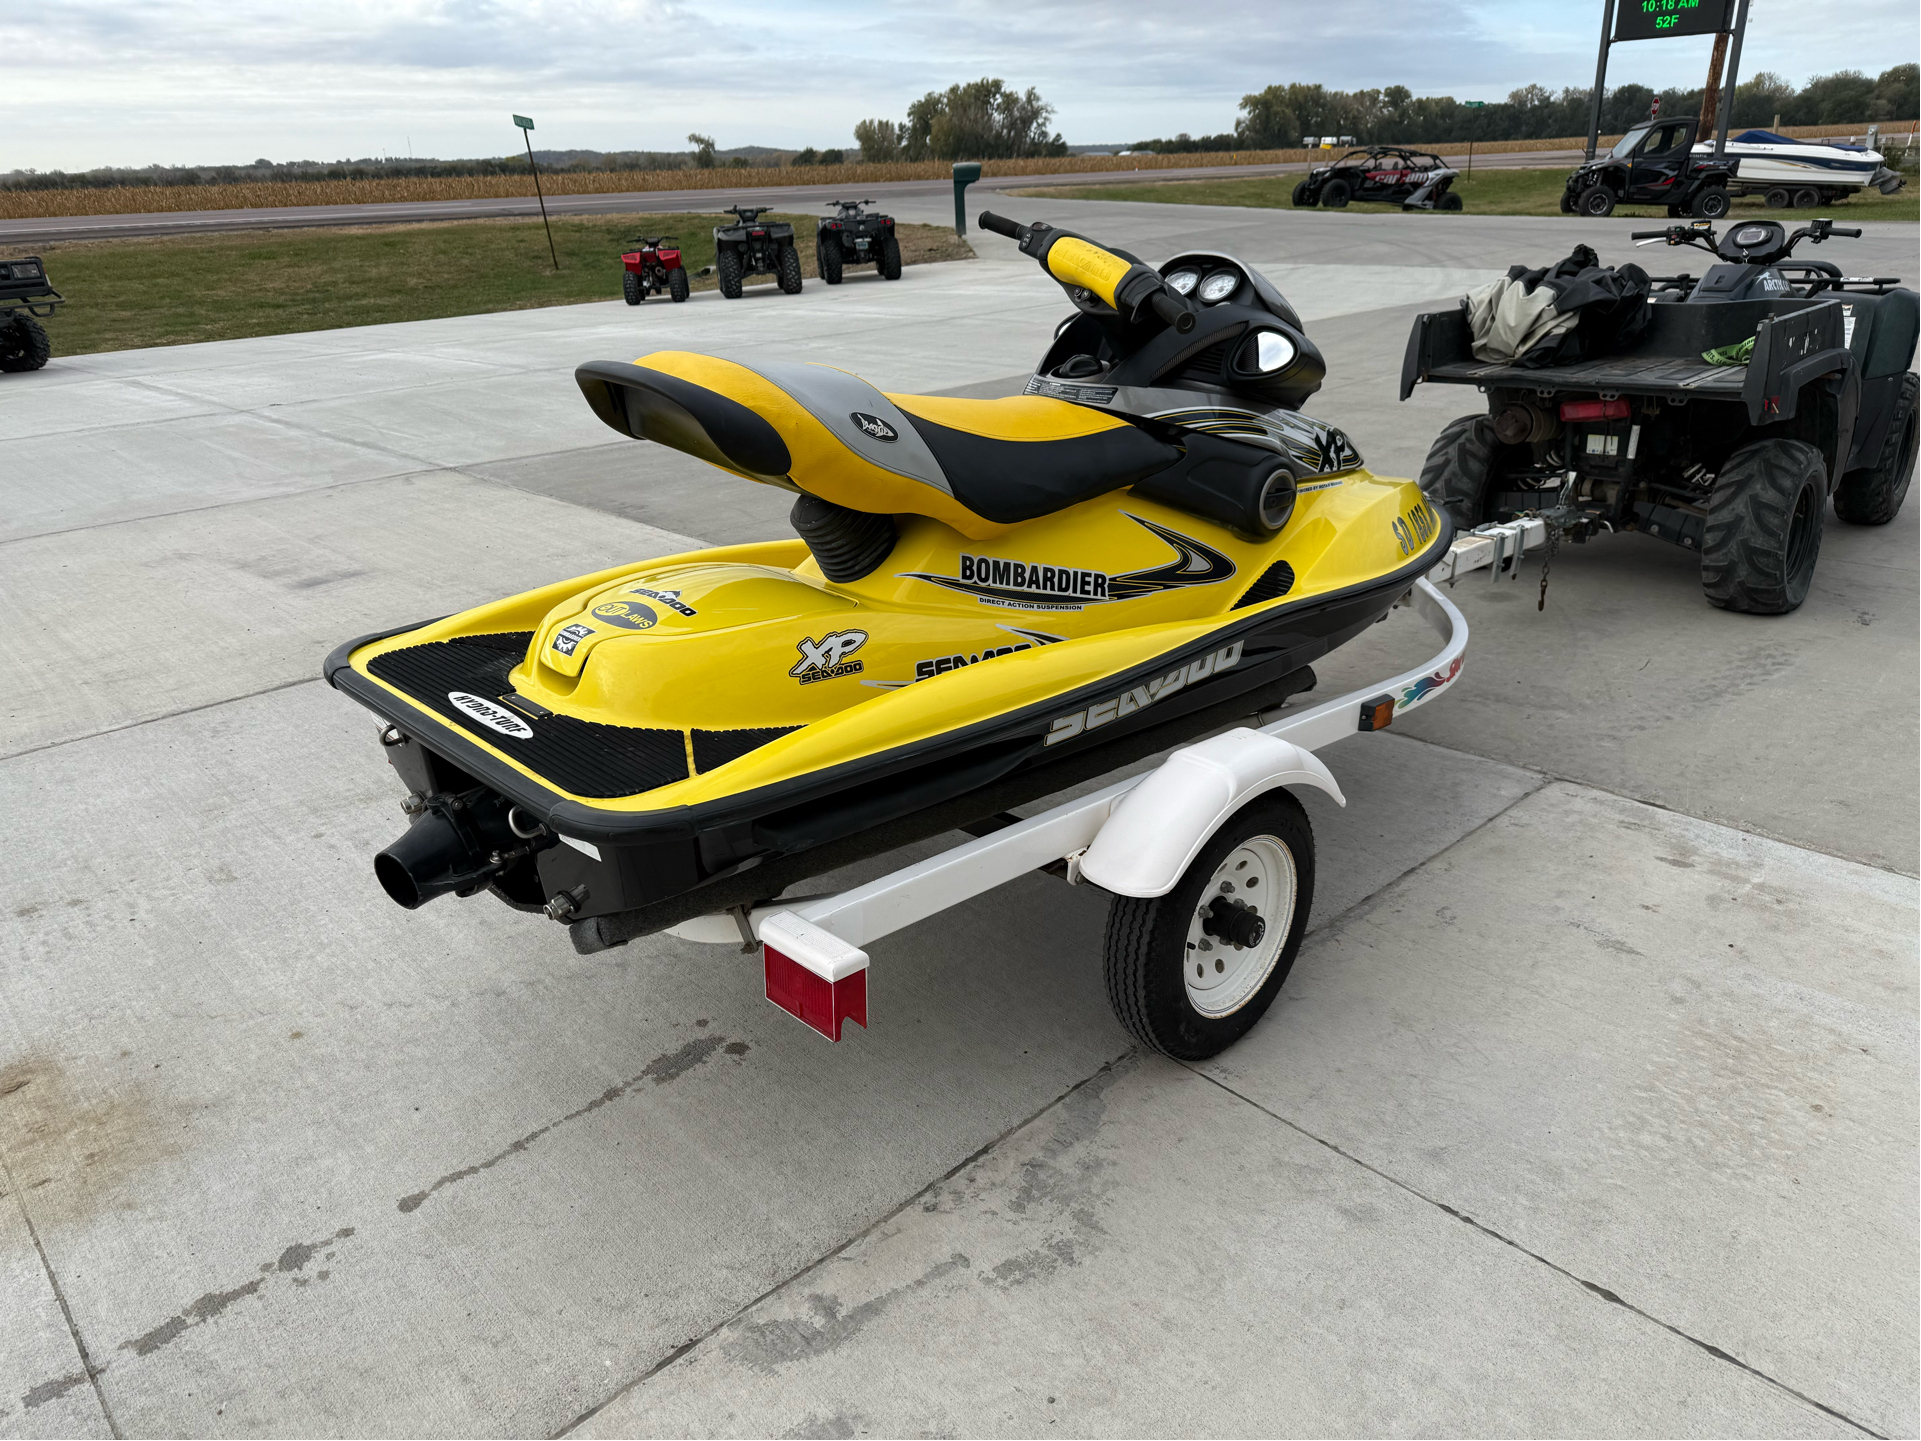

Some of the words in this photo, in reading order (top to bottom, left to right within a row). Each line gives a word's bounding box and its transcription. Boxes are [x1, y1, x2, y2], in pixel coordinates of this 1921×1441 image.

[1641, 0, 1675, 12] 10:18
[1678, 0, 1699, 8] AM
[1655, 15, 1679, 28] 52F
[1315, 427, 1346, 473] XP
[961, 554, 1107, 598] BOMBARDIER
[979, 597, 1005, 606] DIRECT
[1007, 601, 1035, 609] ACTION
[791, 630, 868, 676] XP
[453, 695, 527, 732] HYDRO-TURF
